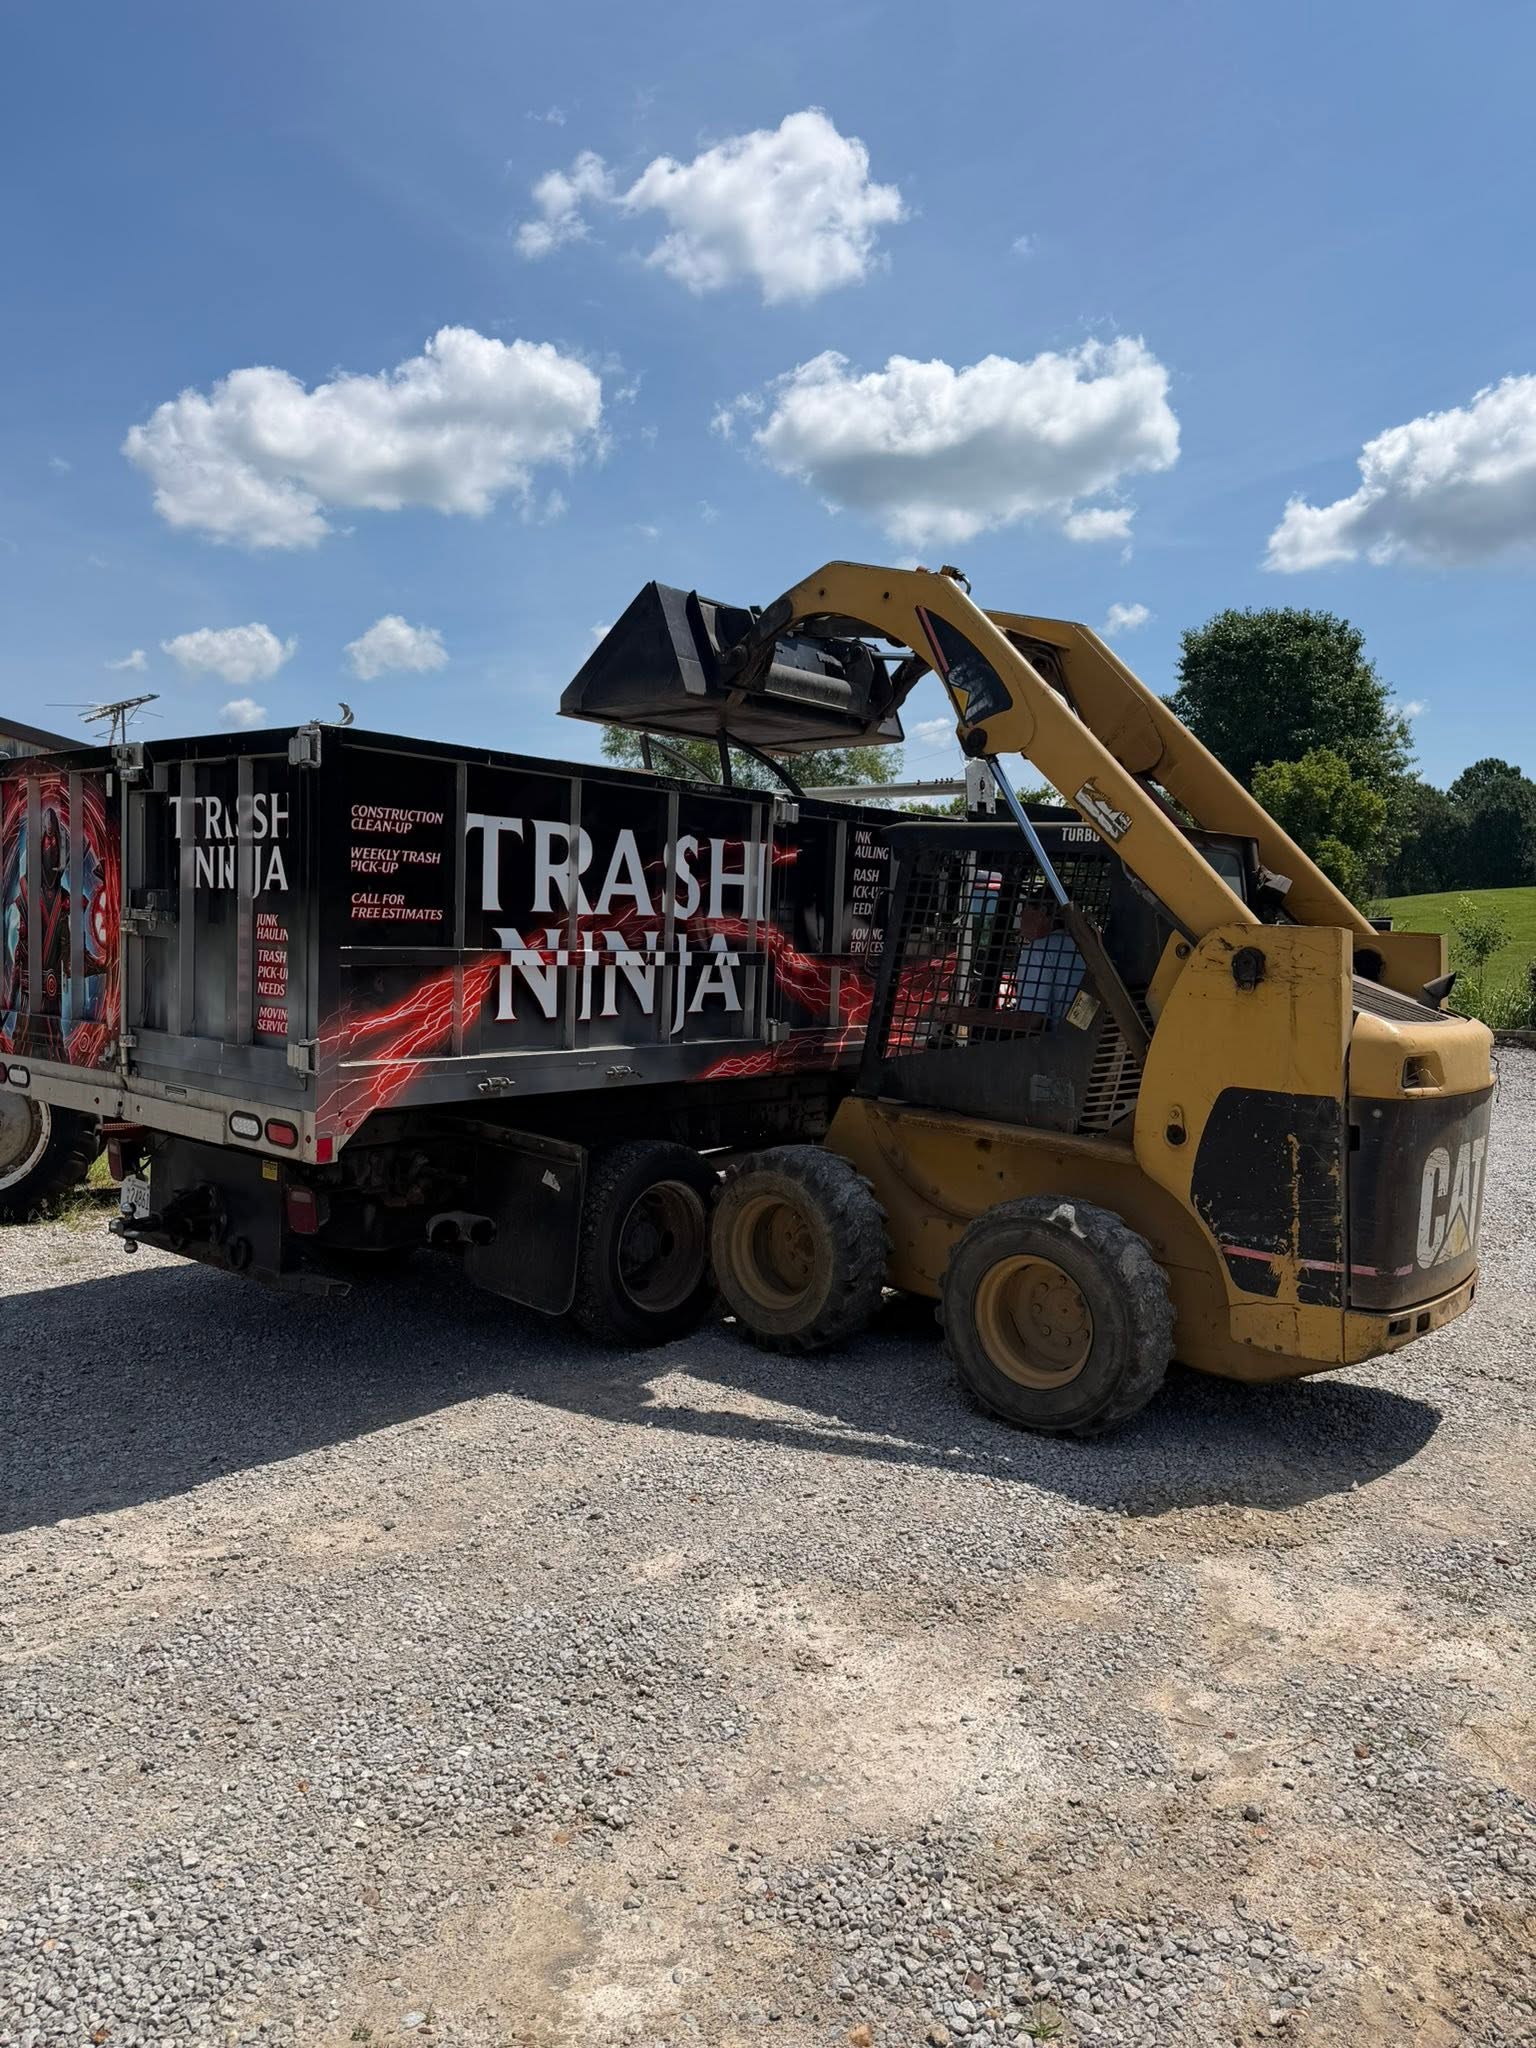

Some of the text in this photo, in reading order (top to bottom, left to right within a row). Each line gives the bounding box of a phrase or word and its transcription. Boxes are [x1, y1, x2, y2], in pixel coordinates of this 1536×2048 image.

[351, 804, 444, 825] CONSTRUCTION
[351, 818, 413, 834] CLEAN-UP
[351, 846, 441, 864] WEEKLY TRASH
[854, 847, 890, 860] AULING
[194, 845, 289, 899] NINJA
[351, 860, 399, 873] PICK-UP
[465, 813, 768, 921] TRASH
[853, 868, 880, 882] RASH
[351, 892, 405, 905] CALL FOR
[852, 885, 881, 899] ICK-U
[351, 907, 444, 921] FREE ESTIMATES
[852, 902, 873, 916] EED
[256, 913, 279, 928] JUNK
[257, 927, 289, 941] HAULIN
[258, 949, 287, 963] TRASH
[257, 966, 289, 980] PICK-U
[492, 928, 743, 1035] NINJA
[257, 982, 286, 996] NEEDS
[259, 1006, 289, 1020] MOVIN
[257, 1019, 288, 1034] SERVICE
[1416, 1136, 1487, 1270] CAT
